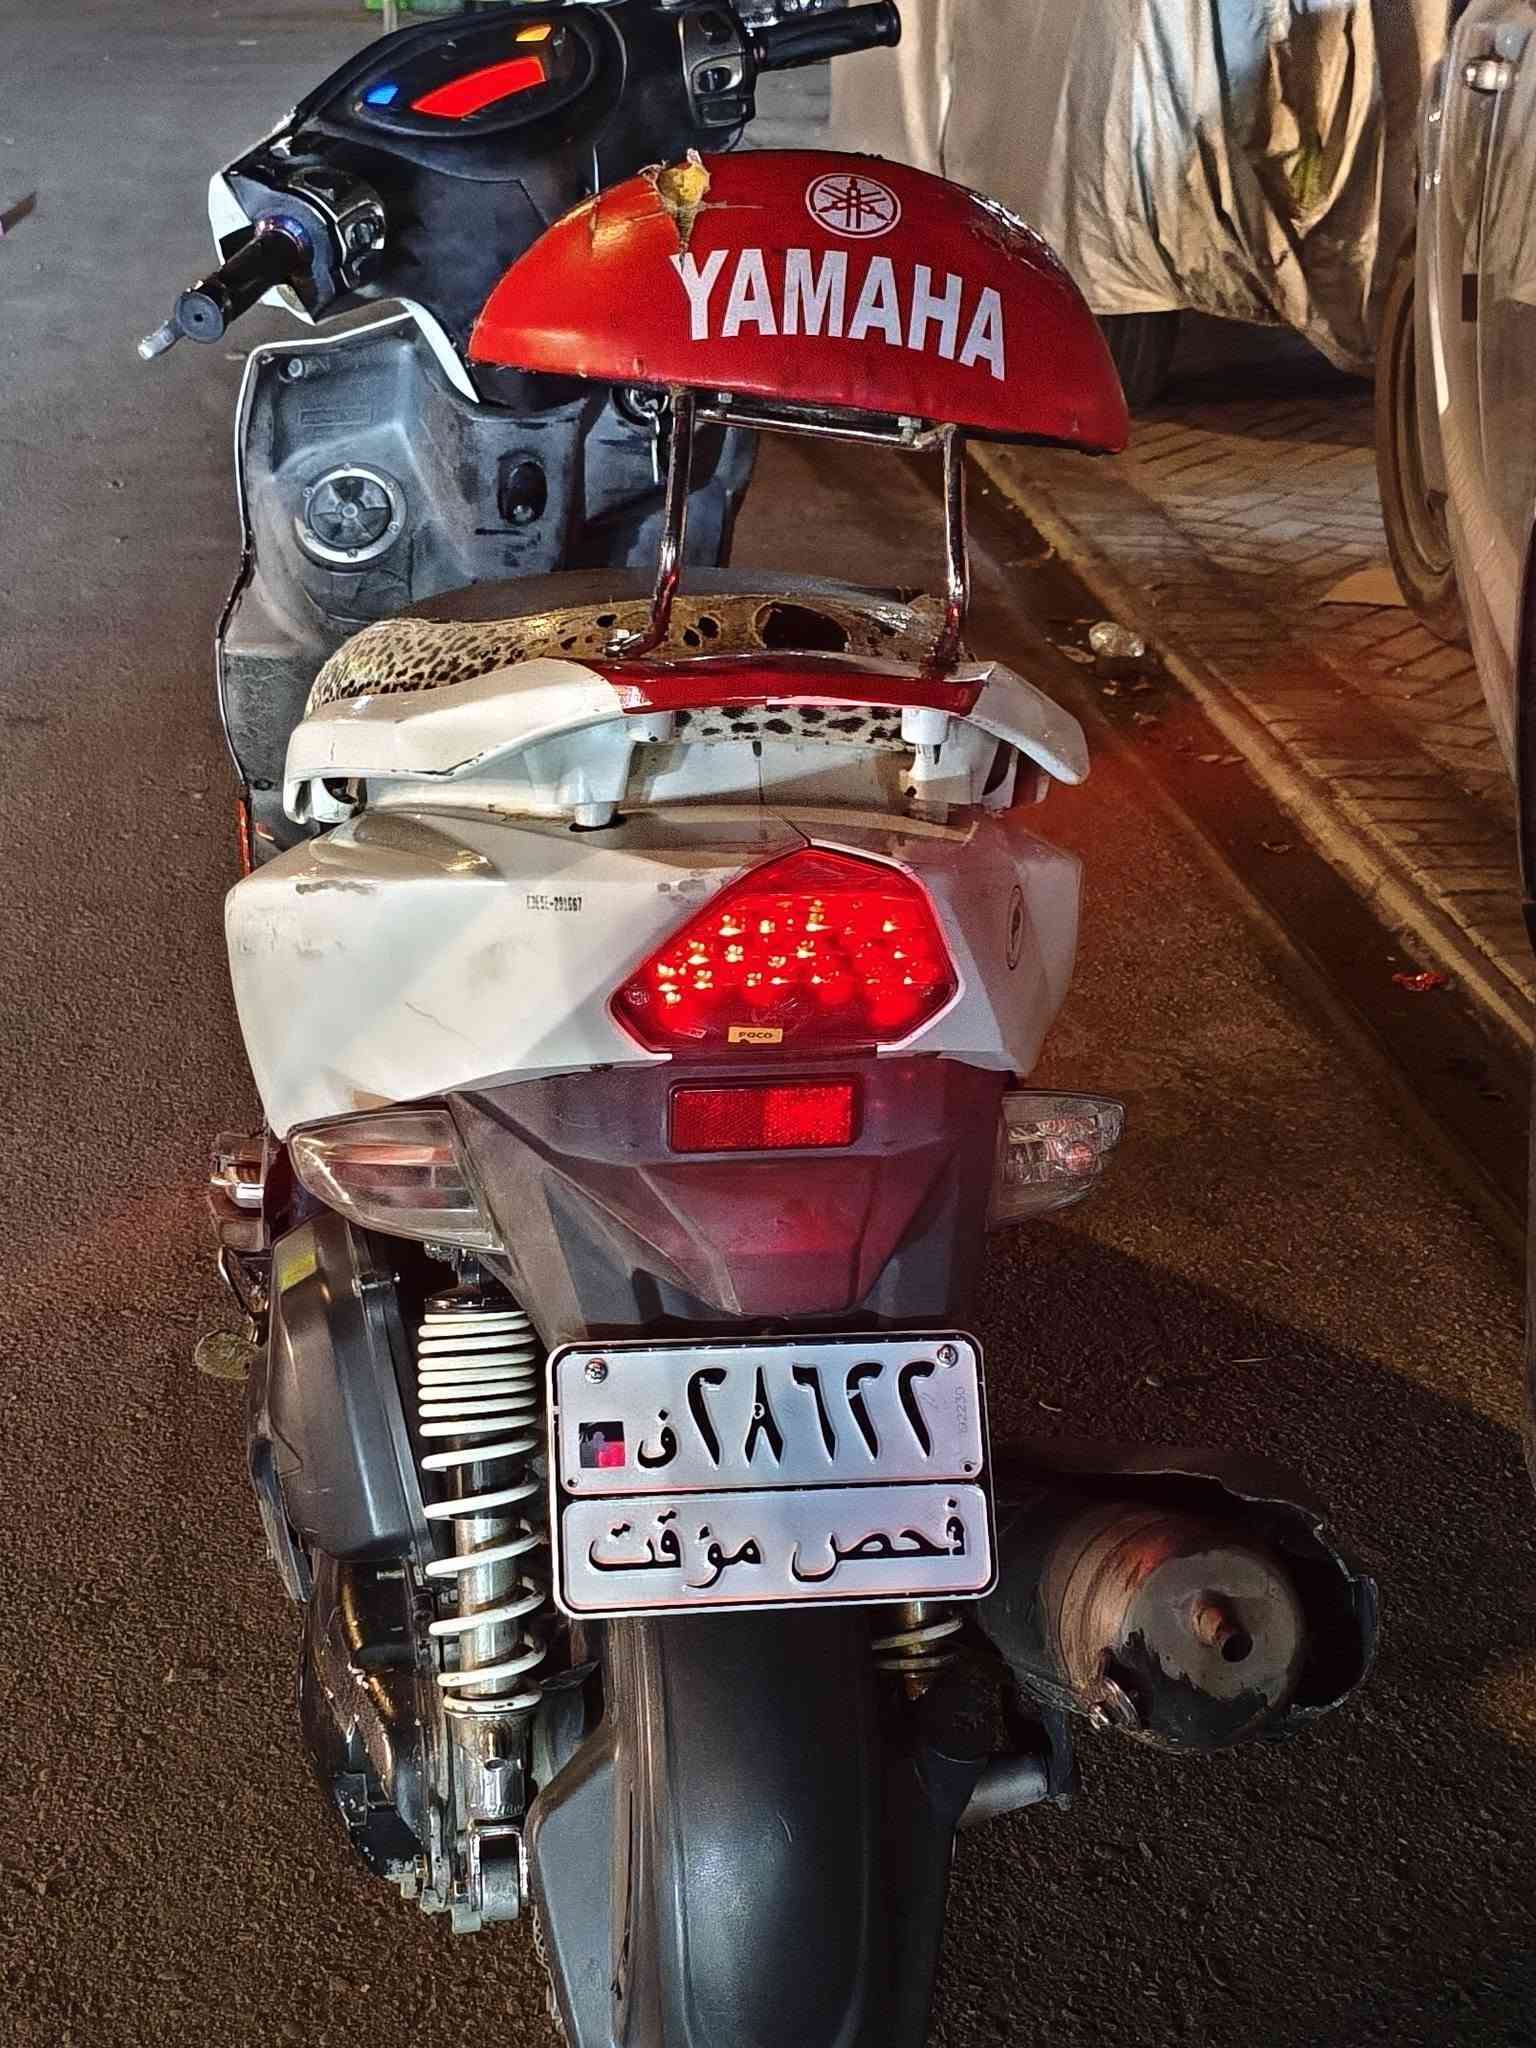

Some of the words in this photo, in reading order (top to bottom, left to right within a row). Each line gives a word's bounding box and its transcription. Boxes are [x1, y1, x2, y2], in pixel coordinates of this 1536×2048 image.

[669, 249, 1004, 381] YAMAHA
[738, 1031, 773, 1039] POCO
[588, 1510, 761, 1589] مؤقت
[792, 1498, 965, 1582] فحص
